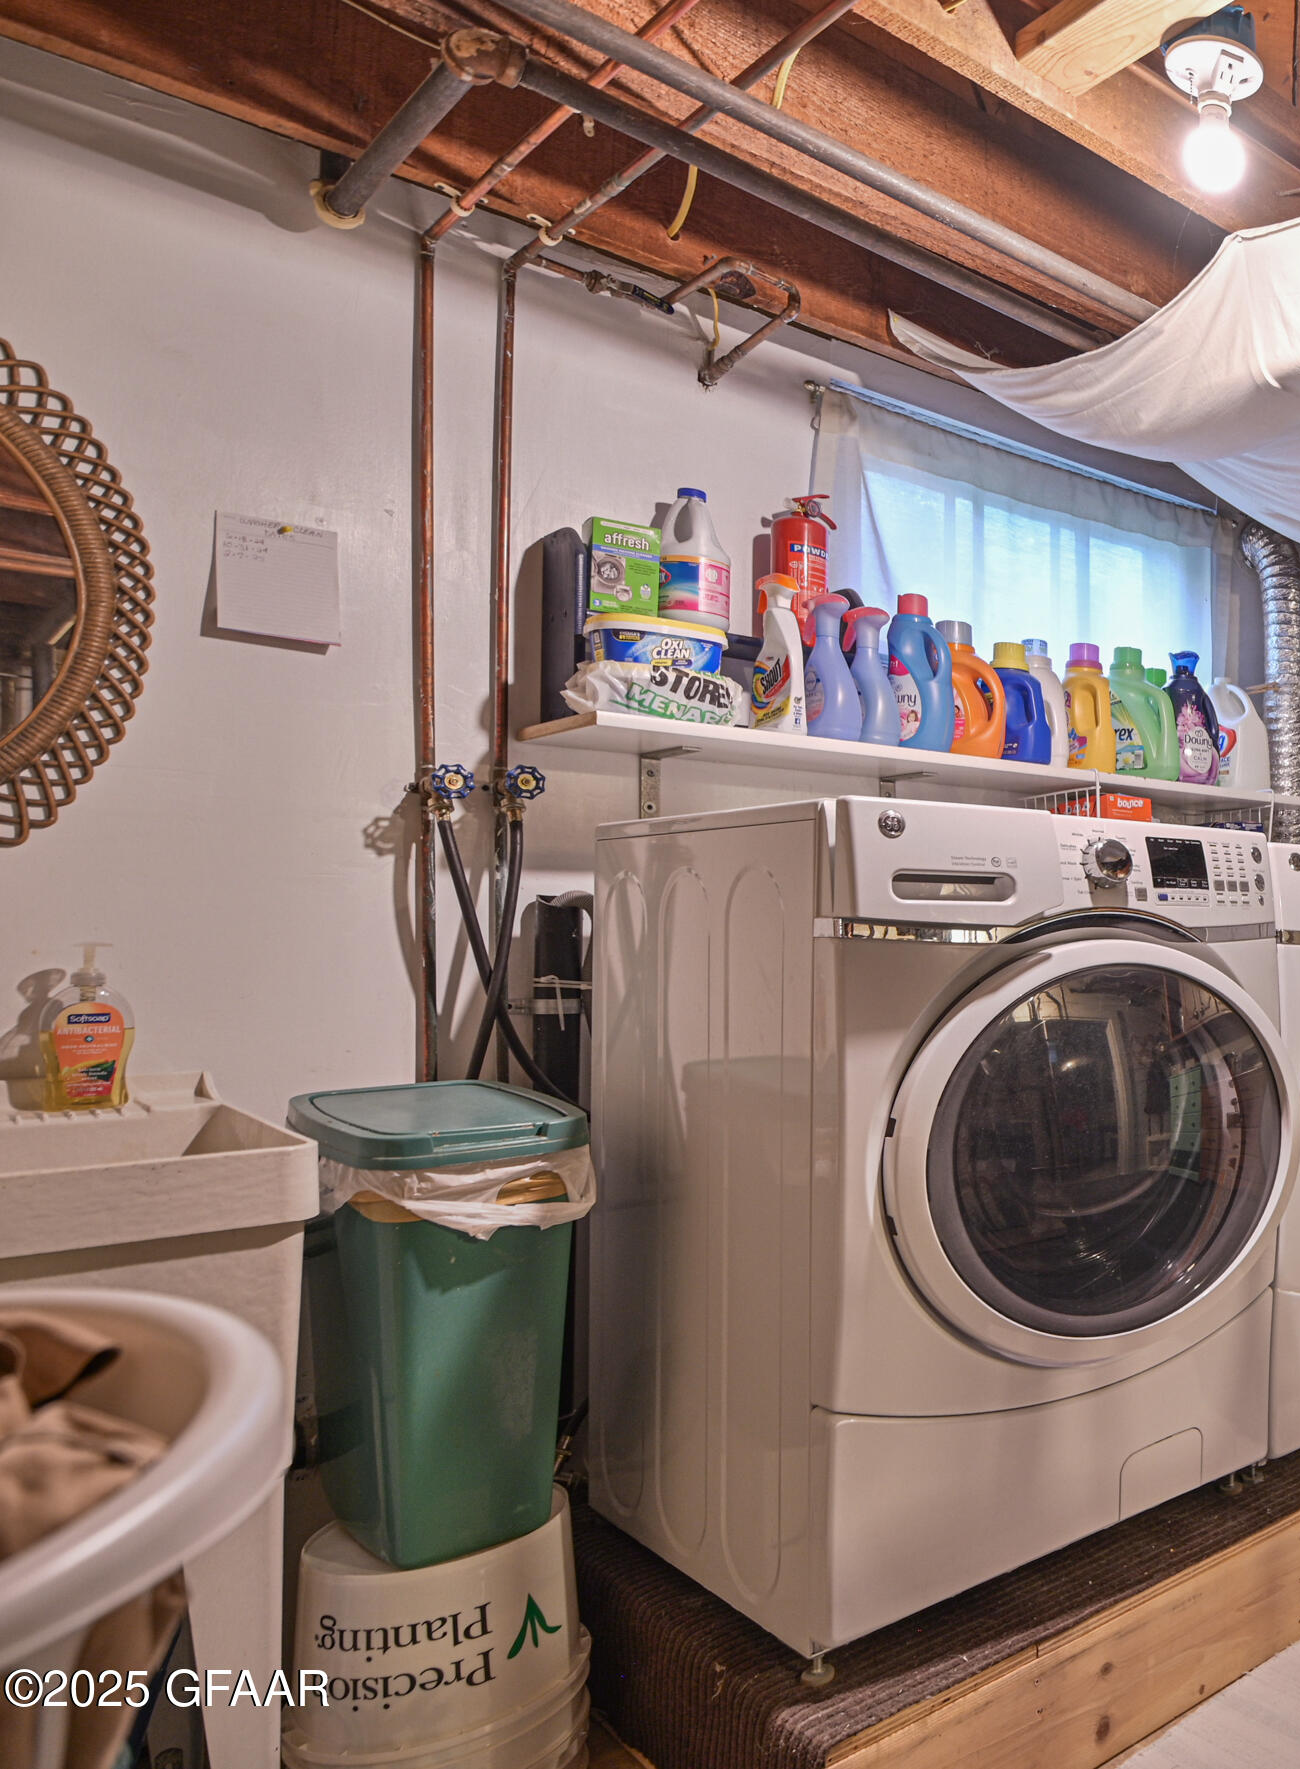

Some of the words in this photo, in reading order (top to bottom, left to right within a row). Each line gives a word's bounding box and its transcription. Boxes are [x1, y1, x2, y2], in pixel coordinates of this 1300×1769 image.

[604, 532, 649, 551] affresh
[661, 638, 684, 650] OXI
[652, 648, 690, 660] CLEAN
[760, 658, 782, 695] SHOUT
[626, 682, 733, 725] MENAR
[1114, 727, 1134, 741] rex
[1184, 734, 1213, 750] Downy
[1117, 798, 1144, 809] bounce
[69, 1014, 110, 1024] Softsoap
[57, 1026, 121, 1035] ANTIBACTERIAL
